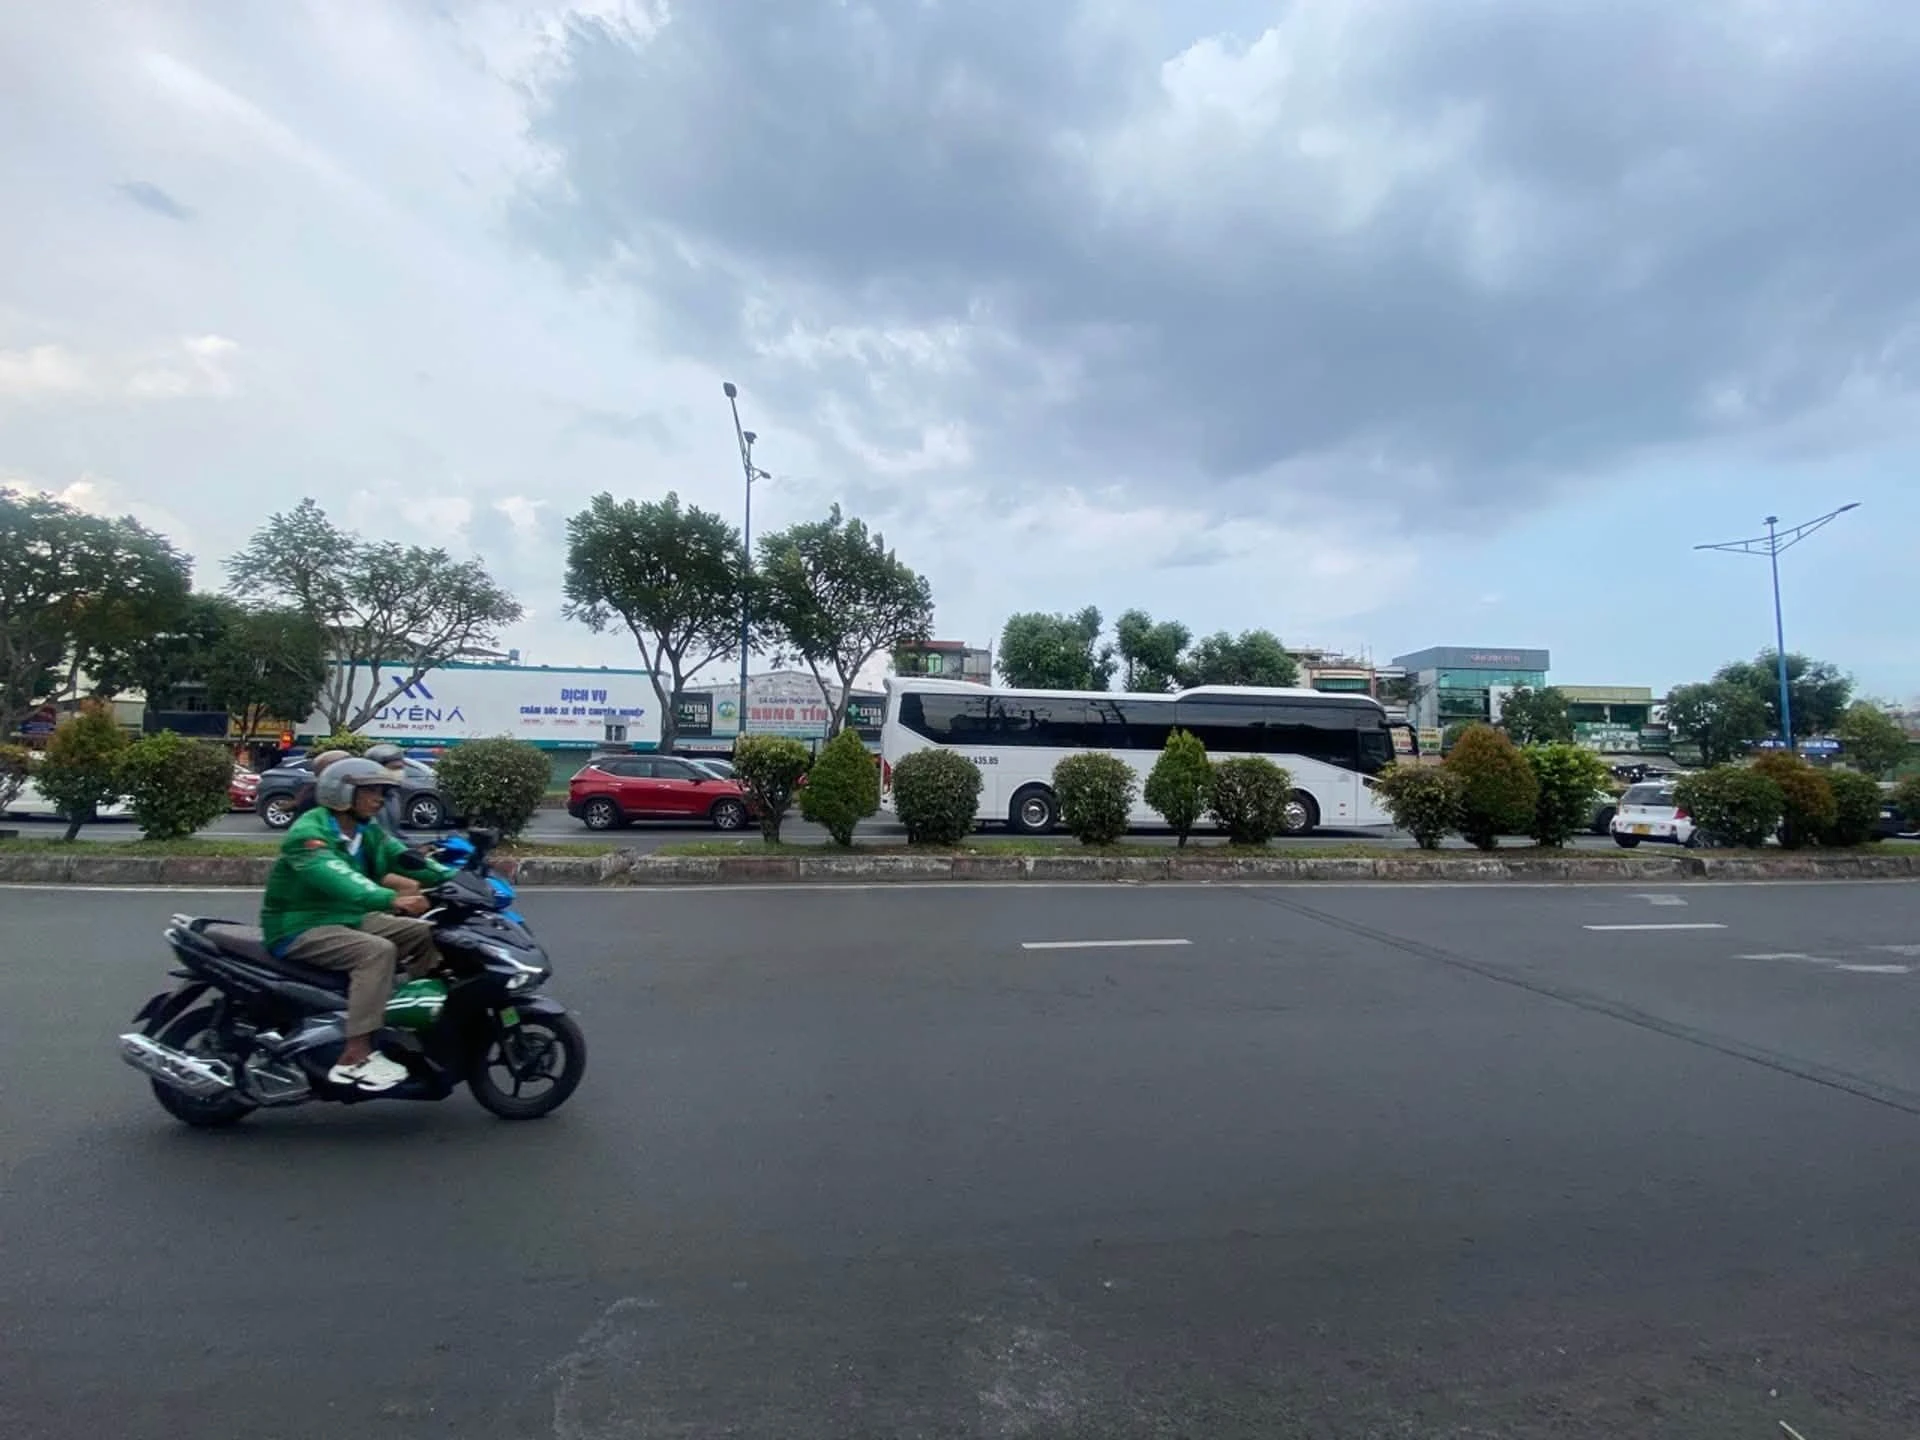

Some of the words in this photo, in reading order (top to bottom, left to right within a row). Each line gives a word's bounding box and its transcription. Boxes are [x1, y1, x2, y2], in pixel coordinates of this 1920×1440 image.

[561, 688, 589, 703] DỊCH
[591, 689, 607, 704] VỤ
[354, 705, 442, 721] UYÊN
